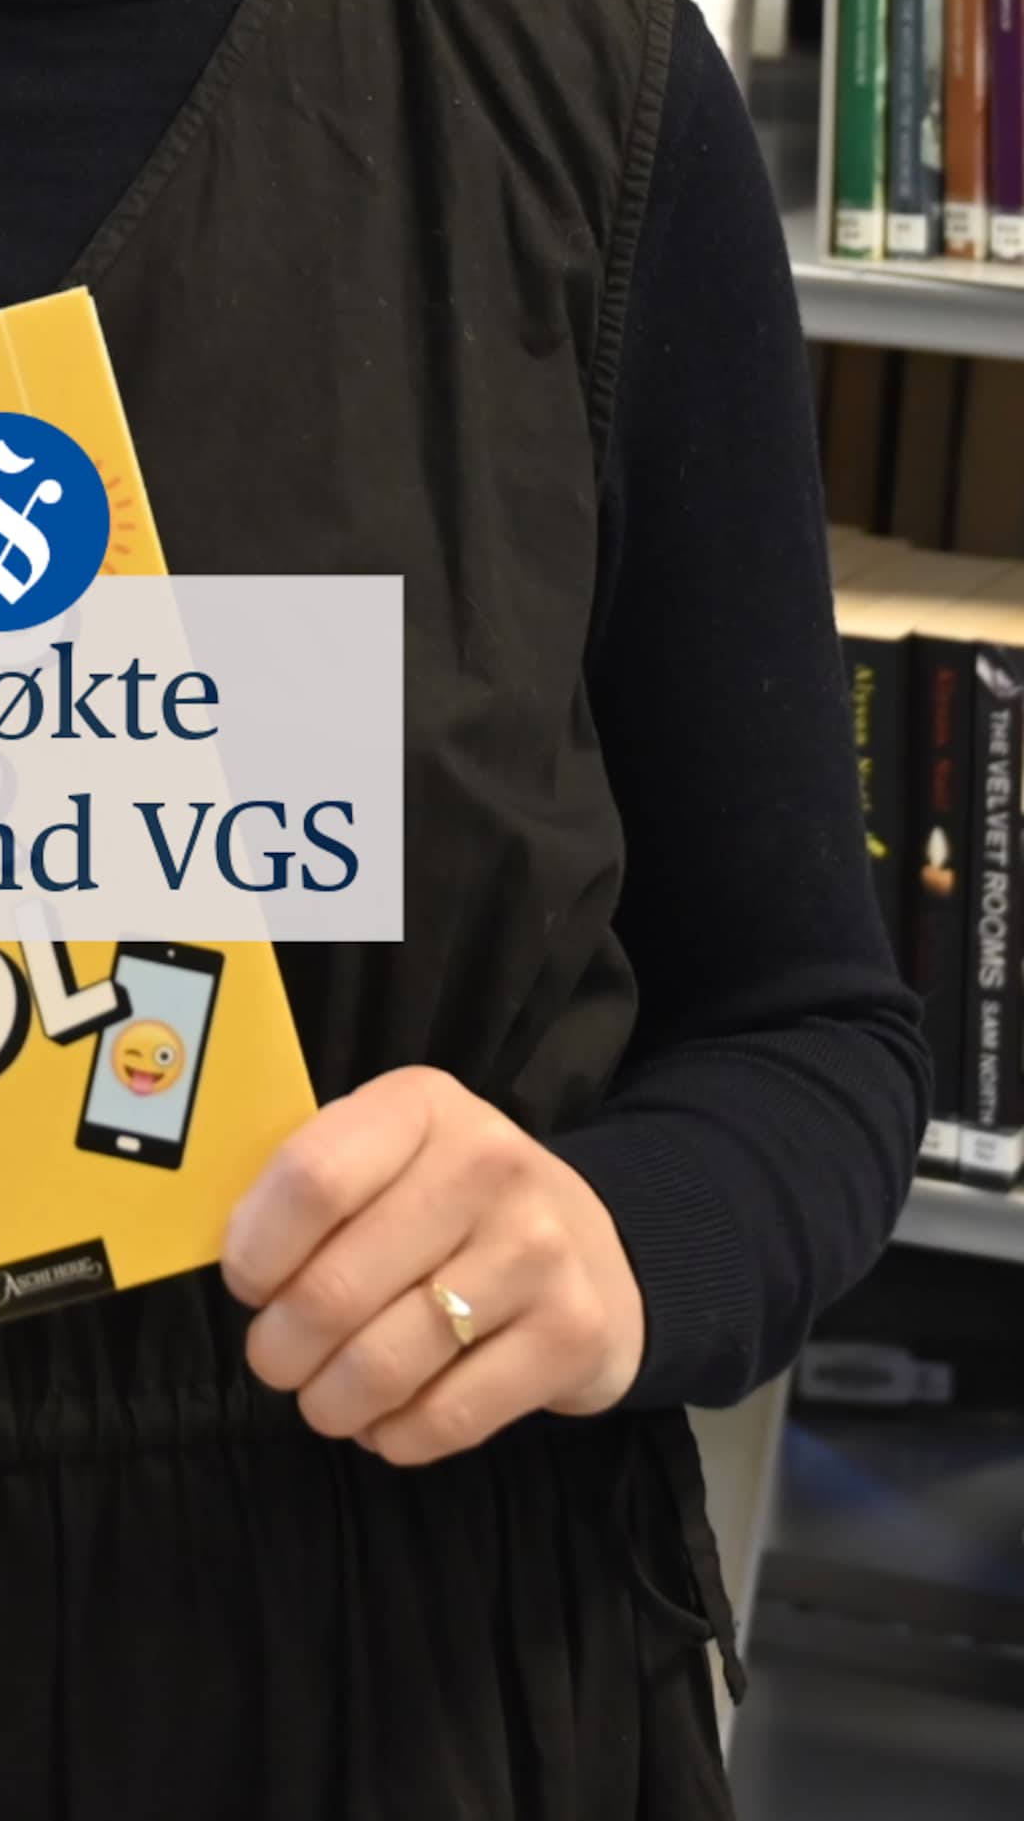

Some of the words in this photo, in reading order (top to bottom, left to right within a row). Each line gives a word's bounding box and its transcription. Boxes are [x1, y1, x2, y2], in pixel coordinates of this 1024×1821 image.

[987, 708, 1012, 757] THE
[984, 758, 1012, 866] VELVET
[977, 870, 1008, 989] ROOMS
[980, 999, 1000, 1050] SAM
